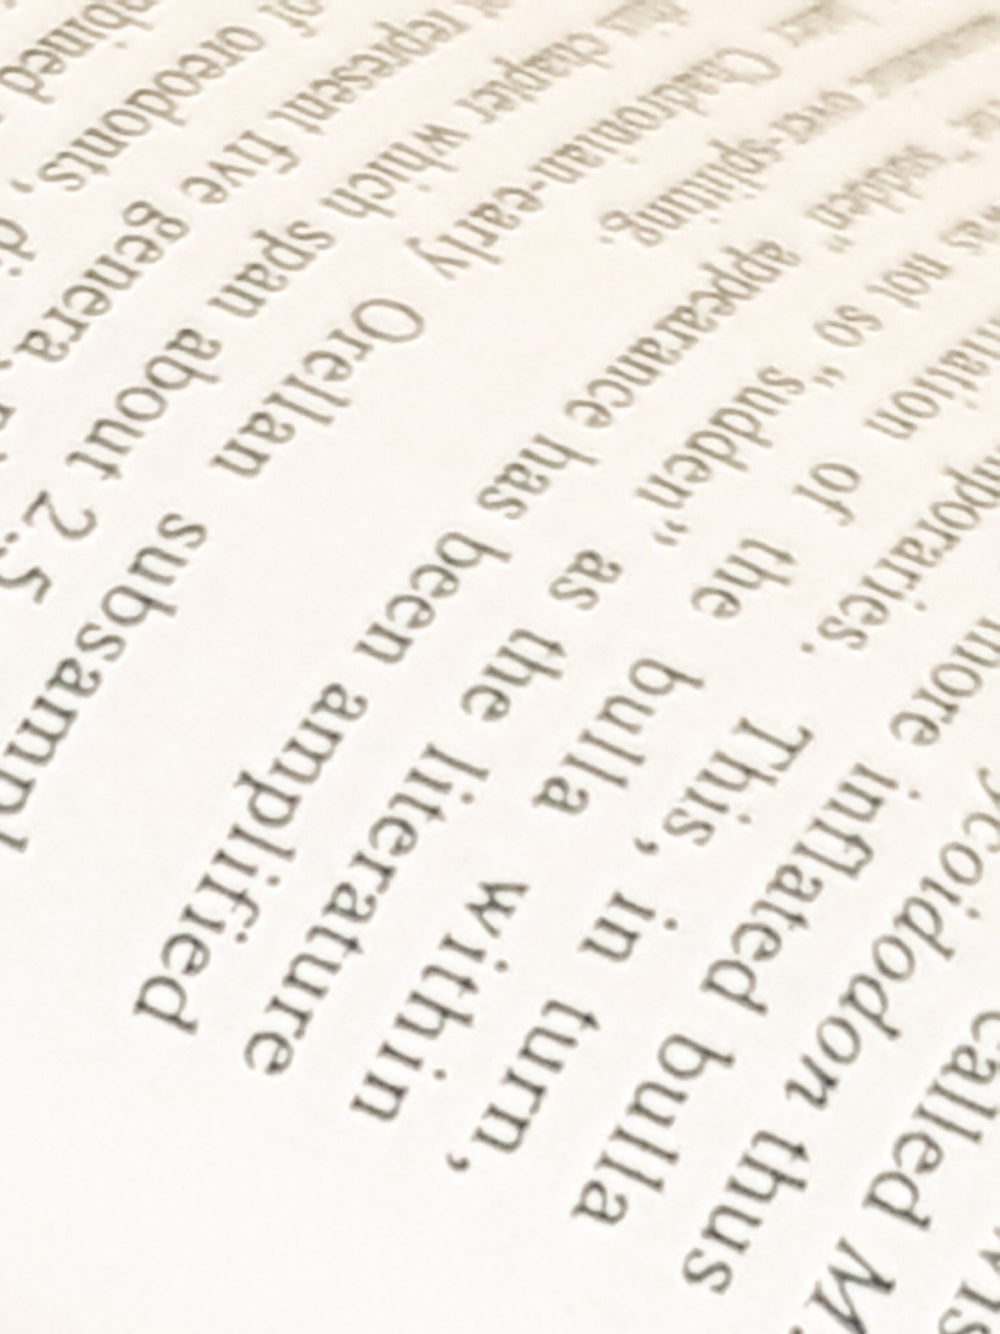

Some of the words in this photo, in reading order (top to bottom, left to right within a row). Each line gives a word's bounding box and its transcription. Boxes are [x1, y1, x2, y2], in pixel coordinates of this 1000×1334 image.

[11, 6, 265, 193] oreodonts,
[268, 9, 469, 134] represent
[456, 33, 609, 123] chapter
[180, 130, 299, 204] five
[320, 124, 470, 218] which
[405, 49, 780, 279] Chadronian-early
[207, 220, 335, 318] span
[564, 240, 801, 428] appearance
[814, 305, 882, 347] so
[866, 253, 952, 308] not
[65, 328, 222, 480] about
[210, 299, 424, 478] Orellan
[477, 434, 599, 519] has
[793, 463, 861, 526] of
[354, 532, 512, 664] been
[549, 550, 623, 610] as
[691, 539, 796, 618] the
[460, 629, 566, 722] the
[532, 658, 705, 815] bulla
[634, 717, 814, 855] This,
[133, 683, 368, 1035] amplified
[244, 743, 490, 1076] literature
[700, 763, 921, 1016] inflated
[578, 891, 678, 963] in
[350, 881, 530, 1122] within
[446, 999, 600, 1172] turn,
[571, 1033, 736, 1226] bulla
[682, 1130, 810, 1295] thus
